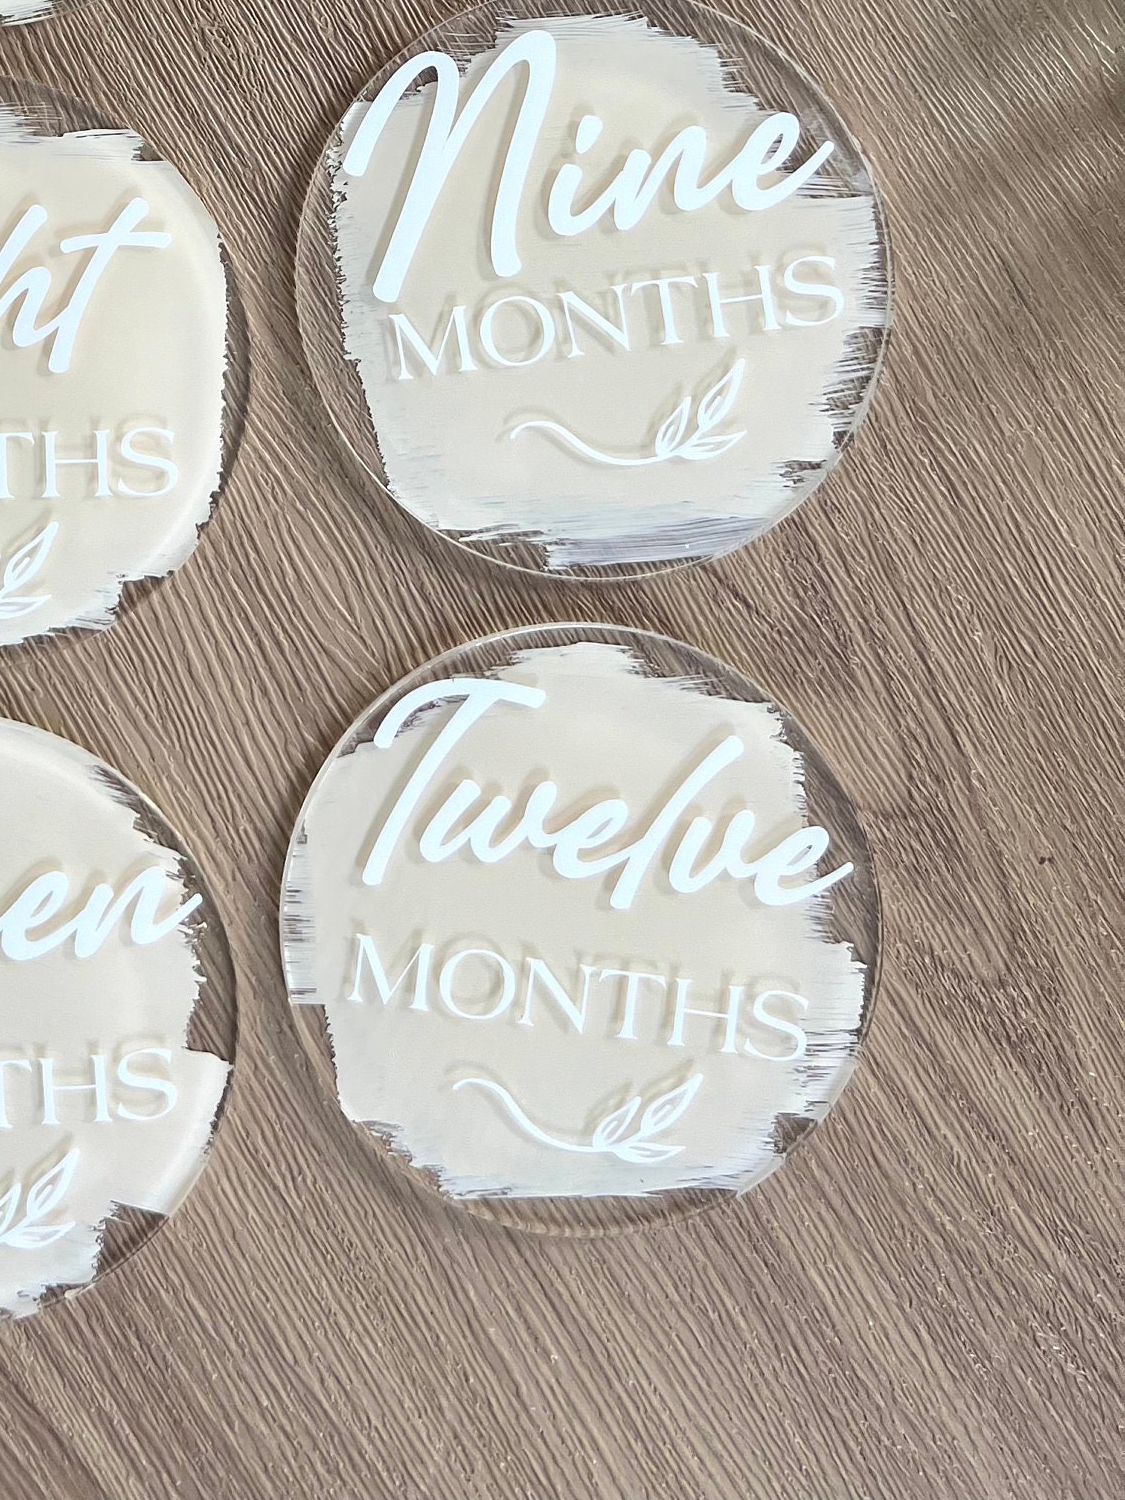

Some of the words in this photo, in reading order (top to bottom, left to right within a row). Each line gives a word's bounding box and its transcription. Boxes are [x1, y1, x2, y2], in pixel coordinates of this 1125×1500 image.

[343, 29, 835, 302] Nine
[388, 255, 846, 381] MONTHS
[361, 677, 854, 910] Twelve
[347, 933, 809, 1062] MONTHS
